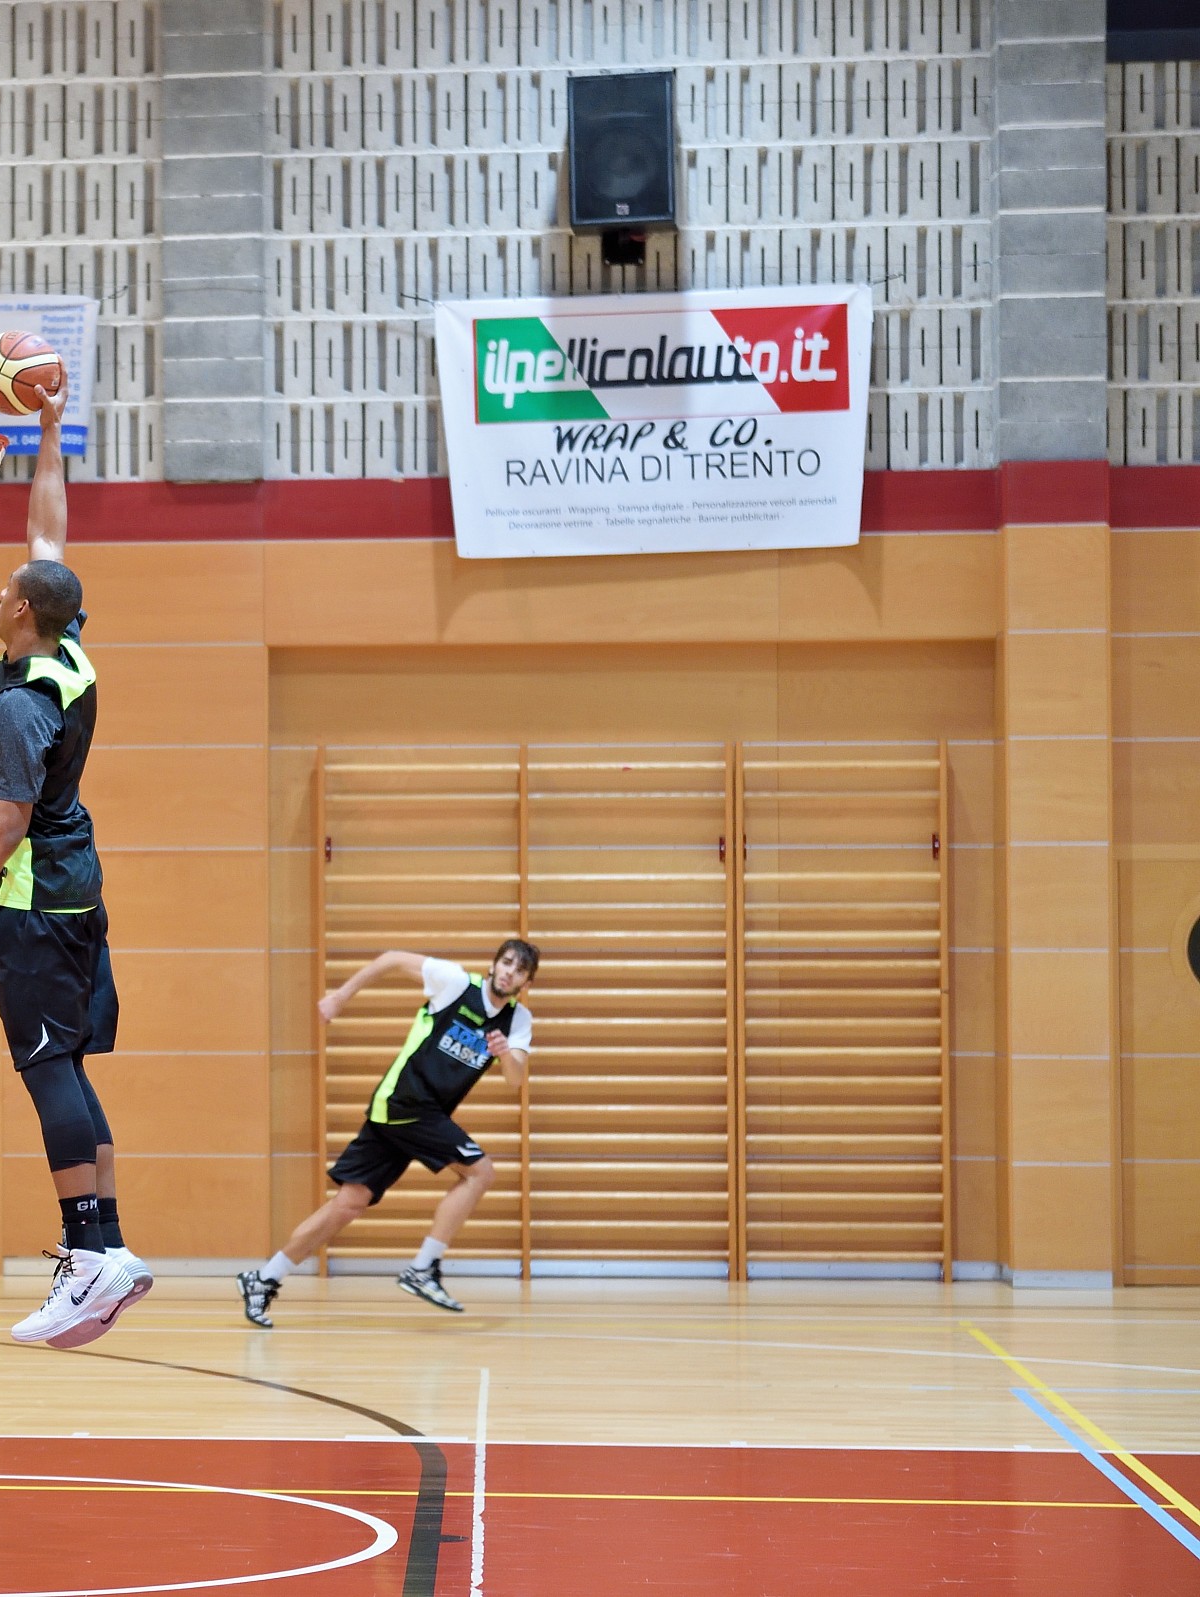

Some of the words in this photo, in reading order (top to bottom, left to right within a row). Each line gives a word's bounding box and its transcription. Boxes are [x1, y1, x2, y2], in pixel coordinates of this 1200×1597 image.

[484, 326, 838, 409] ilpellicolauto.it
[554, 422, 655, 454] WRAP
[663, 420, 689, 450] &
[708, 417, 774, 449] CO.
[506, 457, 630, 487] RAVINA
[642, 454, 671, 482] DI
[683, 448, 822, 480] TRENTO
[485, 507, 520, 518] Pellicole
[522, 506, 562, 517] oscuranti
[567, 505, 611, 516] Wrapping
[617, 503, 650, 514] Stampa
[652, 502, 685, 513] digitale
[692, 499, 768, 511] Personalizzazione
[769, 497, 797, 508] veicoli
[798, 495, 838, 507] aziendali
[508, 520, 562, 531] Decorazione
[563, 519, 594, 528] vetrine
[606, 517, 635, 527] Tabelle
[638, 514, 692, 526] segnaletiche
[699, 513, 728, 524] Banner
[730, 511, 780, 524] pubblicitari
[439, 1034, 491, 1068] BASKE
